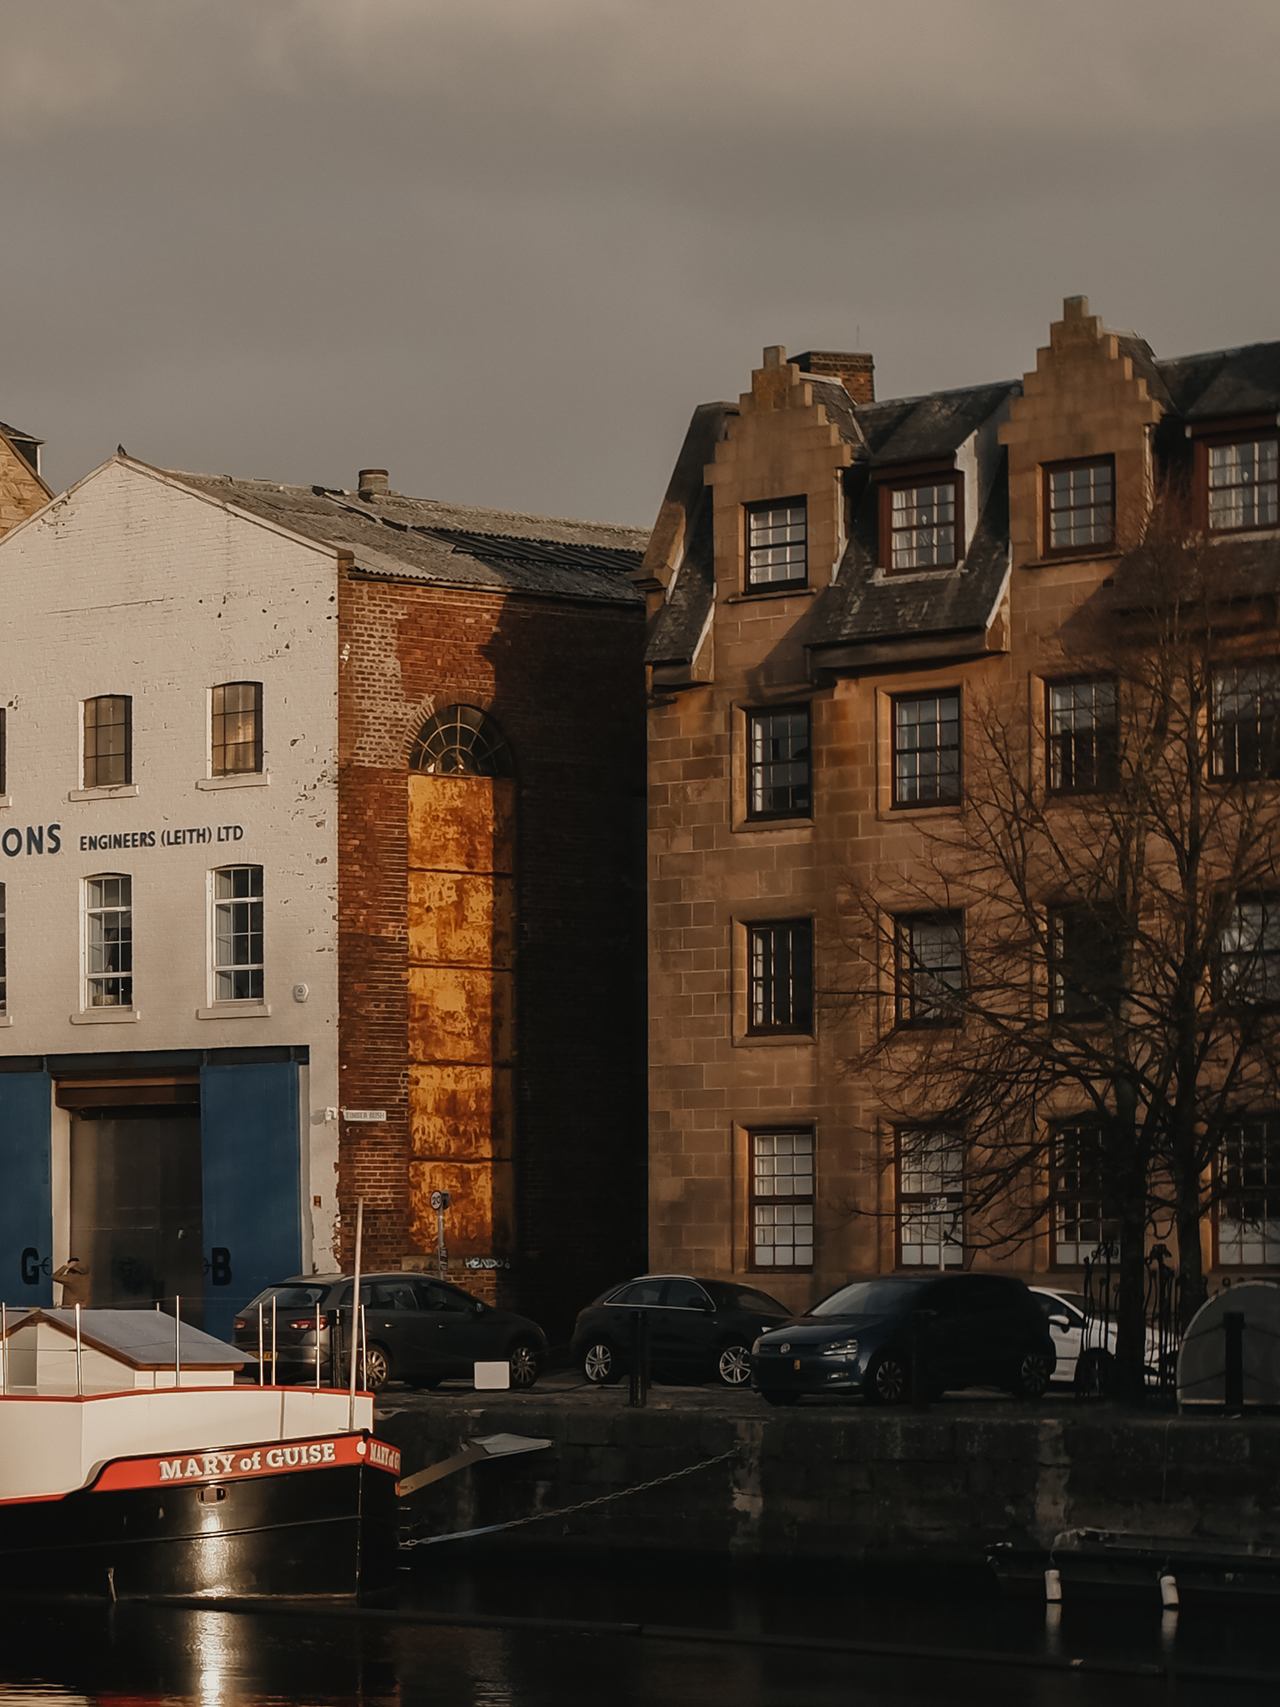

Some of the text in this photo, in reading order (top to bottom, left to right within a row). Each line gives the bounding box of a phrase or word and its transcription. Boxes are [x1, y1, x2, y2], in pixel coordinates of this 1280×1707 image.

[80, 831, 156, 851] ENGINEERS
[161, 826, 212, 847] (LEITH)
[217, 825, 244, 842] LTD
[21, 1247, 40, 1285] G
[211, 1247, 232, 1286] B
[159, 1443, 336, 1481] MARY of GUISE
